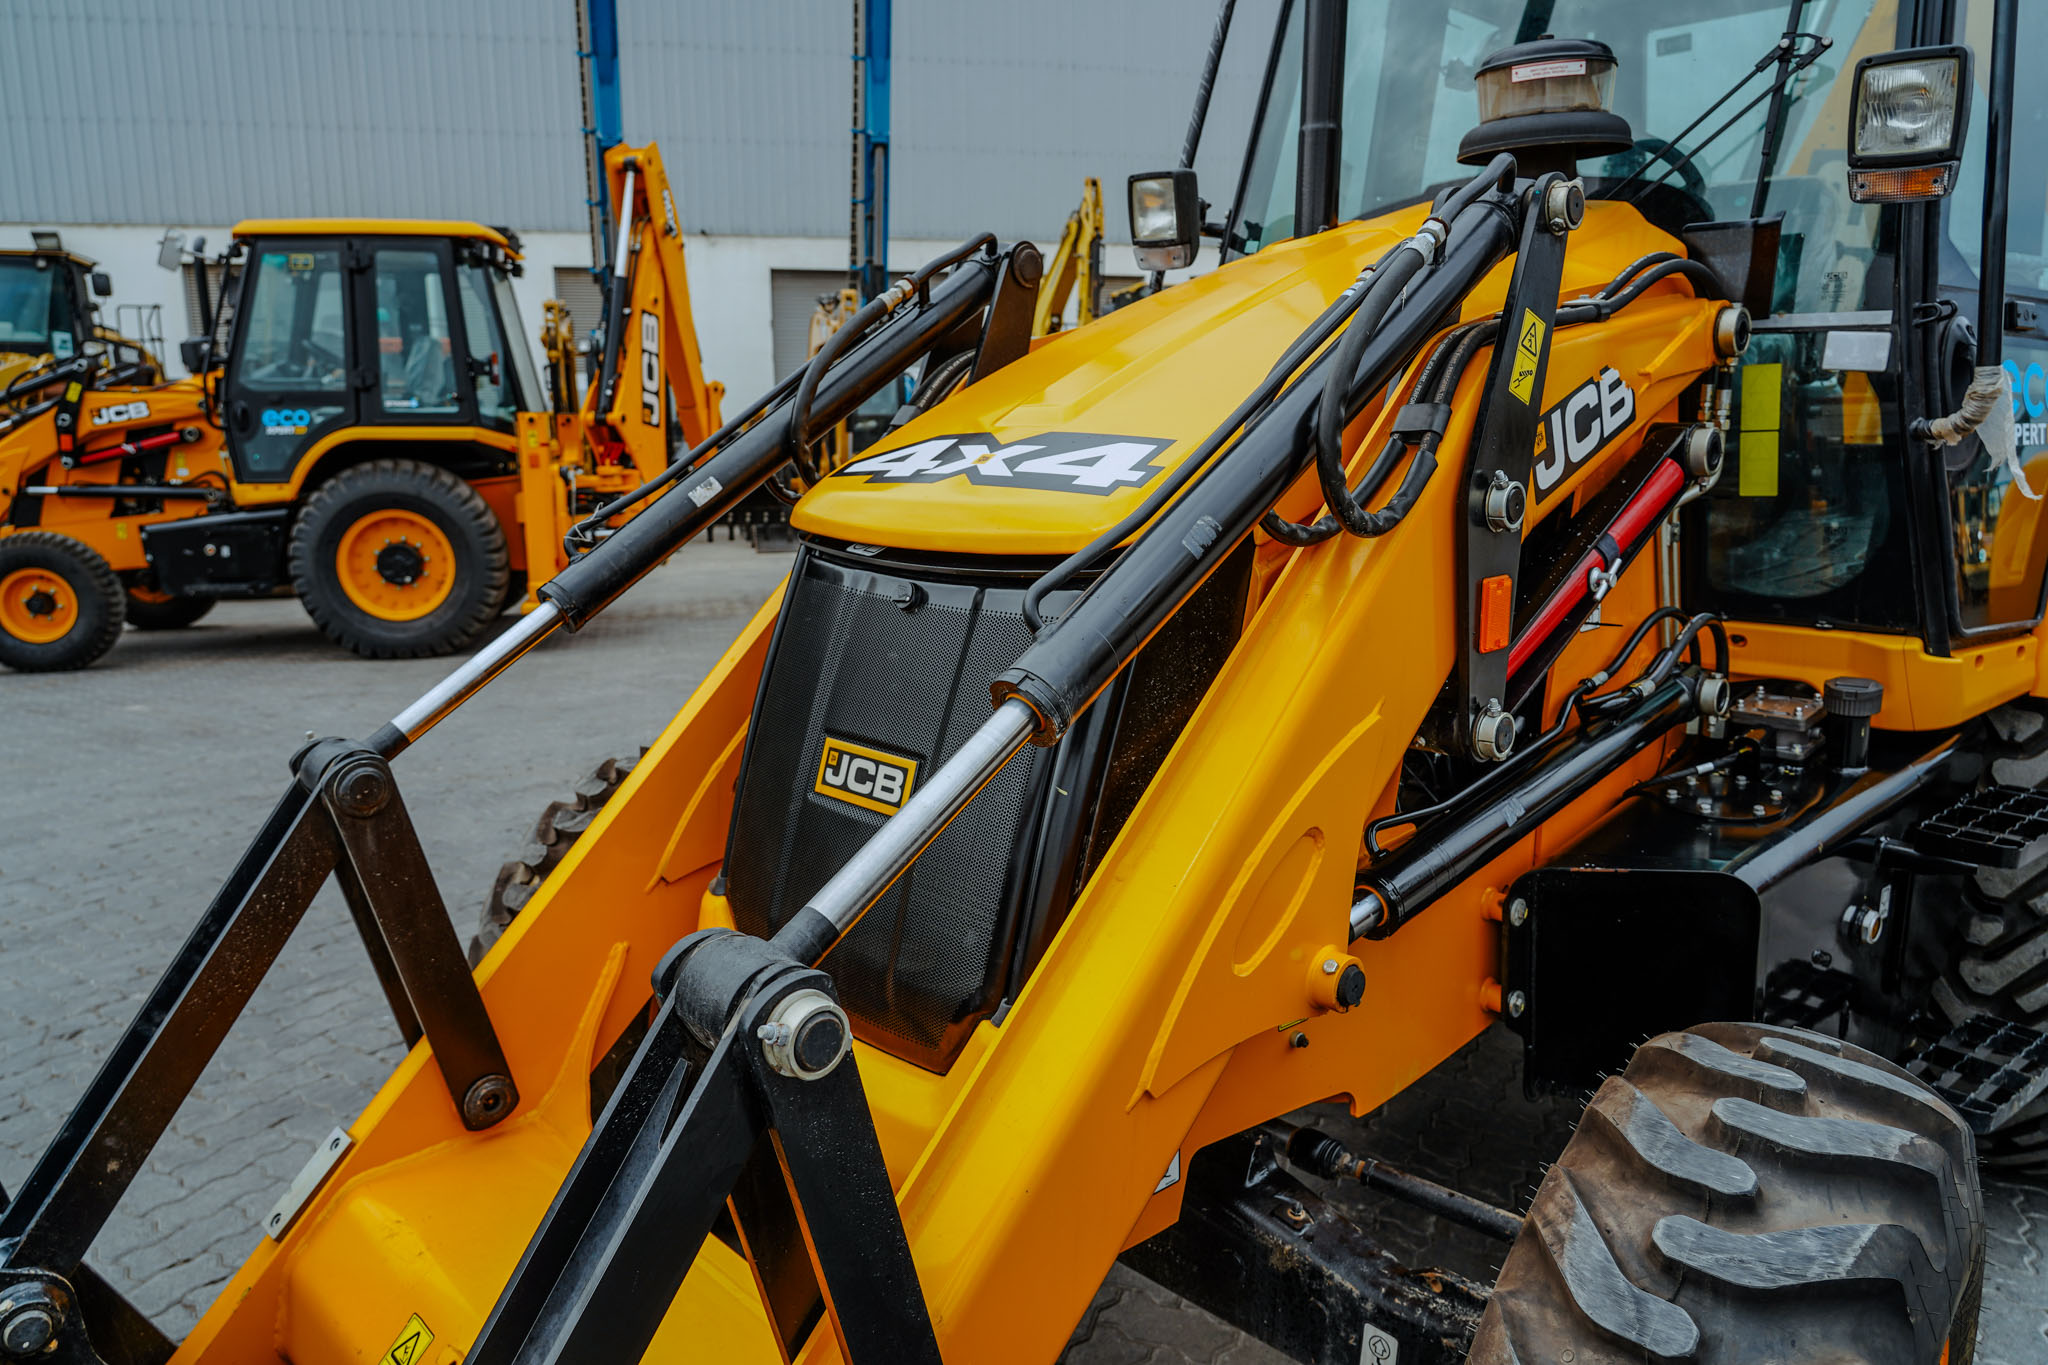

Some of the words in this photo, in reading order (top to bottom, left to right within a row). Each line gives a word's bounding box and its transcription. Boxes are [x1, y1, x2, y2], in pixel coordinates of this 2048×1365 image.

[642, 312, 660, 426] JCB
[2001, 359, 2048, 418] ec
[92, 401, 150, 425] JCB
[261, 408, 311, 426] eco
[1535, 367, 1634, 490] JCB
[2014, 423, 2047, 446] PERT
[825, 754, 904, 803] JCB
